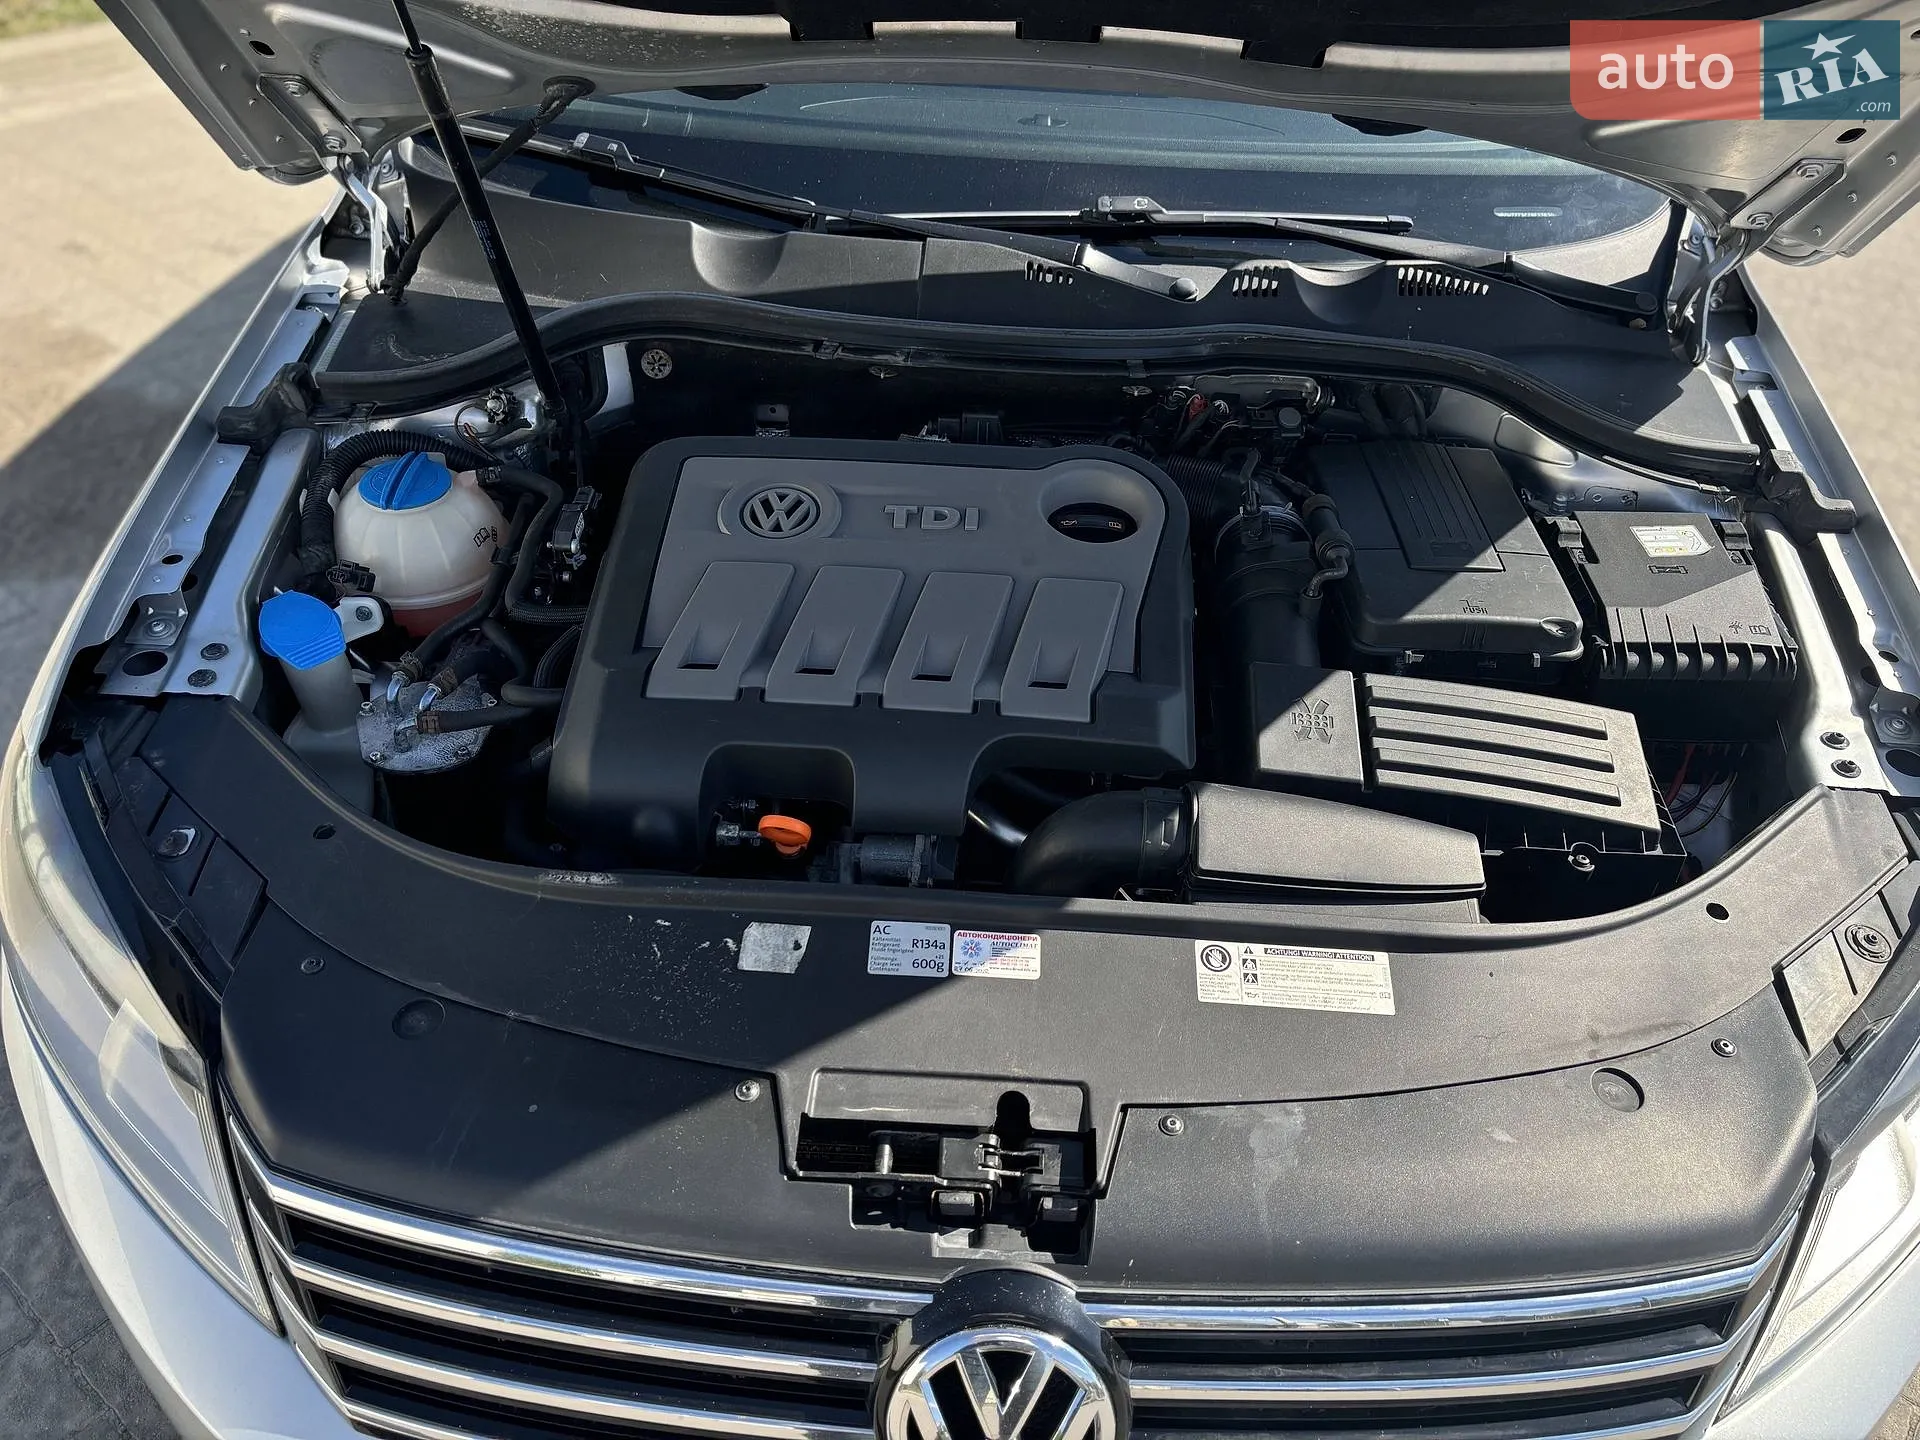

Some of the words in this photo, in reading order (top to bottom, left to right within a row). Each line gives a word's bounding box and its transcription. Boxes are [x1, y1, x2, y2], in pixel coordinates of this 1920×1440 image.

[744, 487, 818, 537] VW
[884, 504, 980, 531] TDI
[1462, 606, 1489, 615] PUSH
[873, 925, 891, 935] AC
[957, 931, 1038, 941] АВТОКОНДИЦІОНЕРИ
[912, 938, 946, 950] R134a
[1266, 948, 1300, 957] ACHTUNG!
[1301, 950, 1335, 959] WARNING!
[1336, 953, 1373, 962] ATTENTION!
[912, 958, 945, 973] 600g
